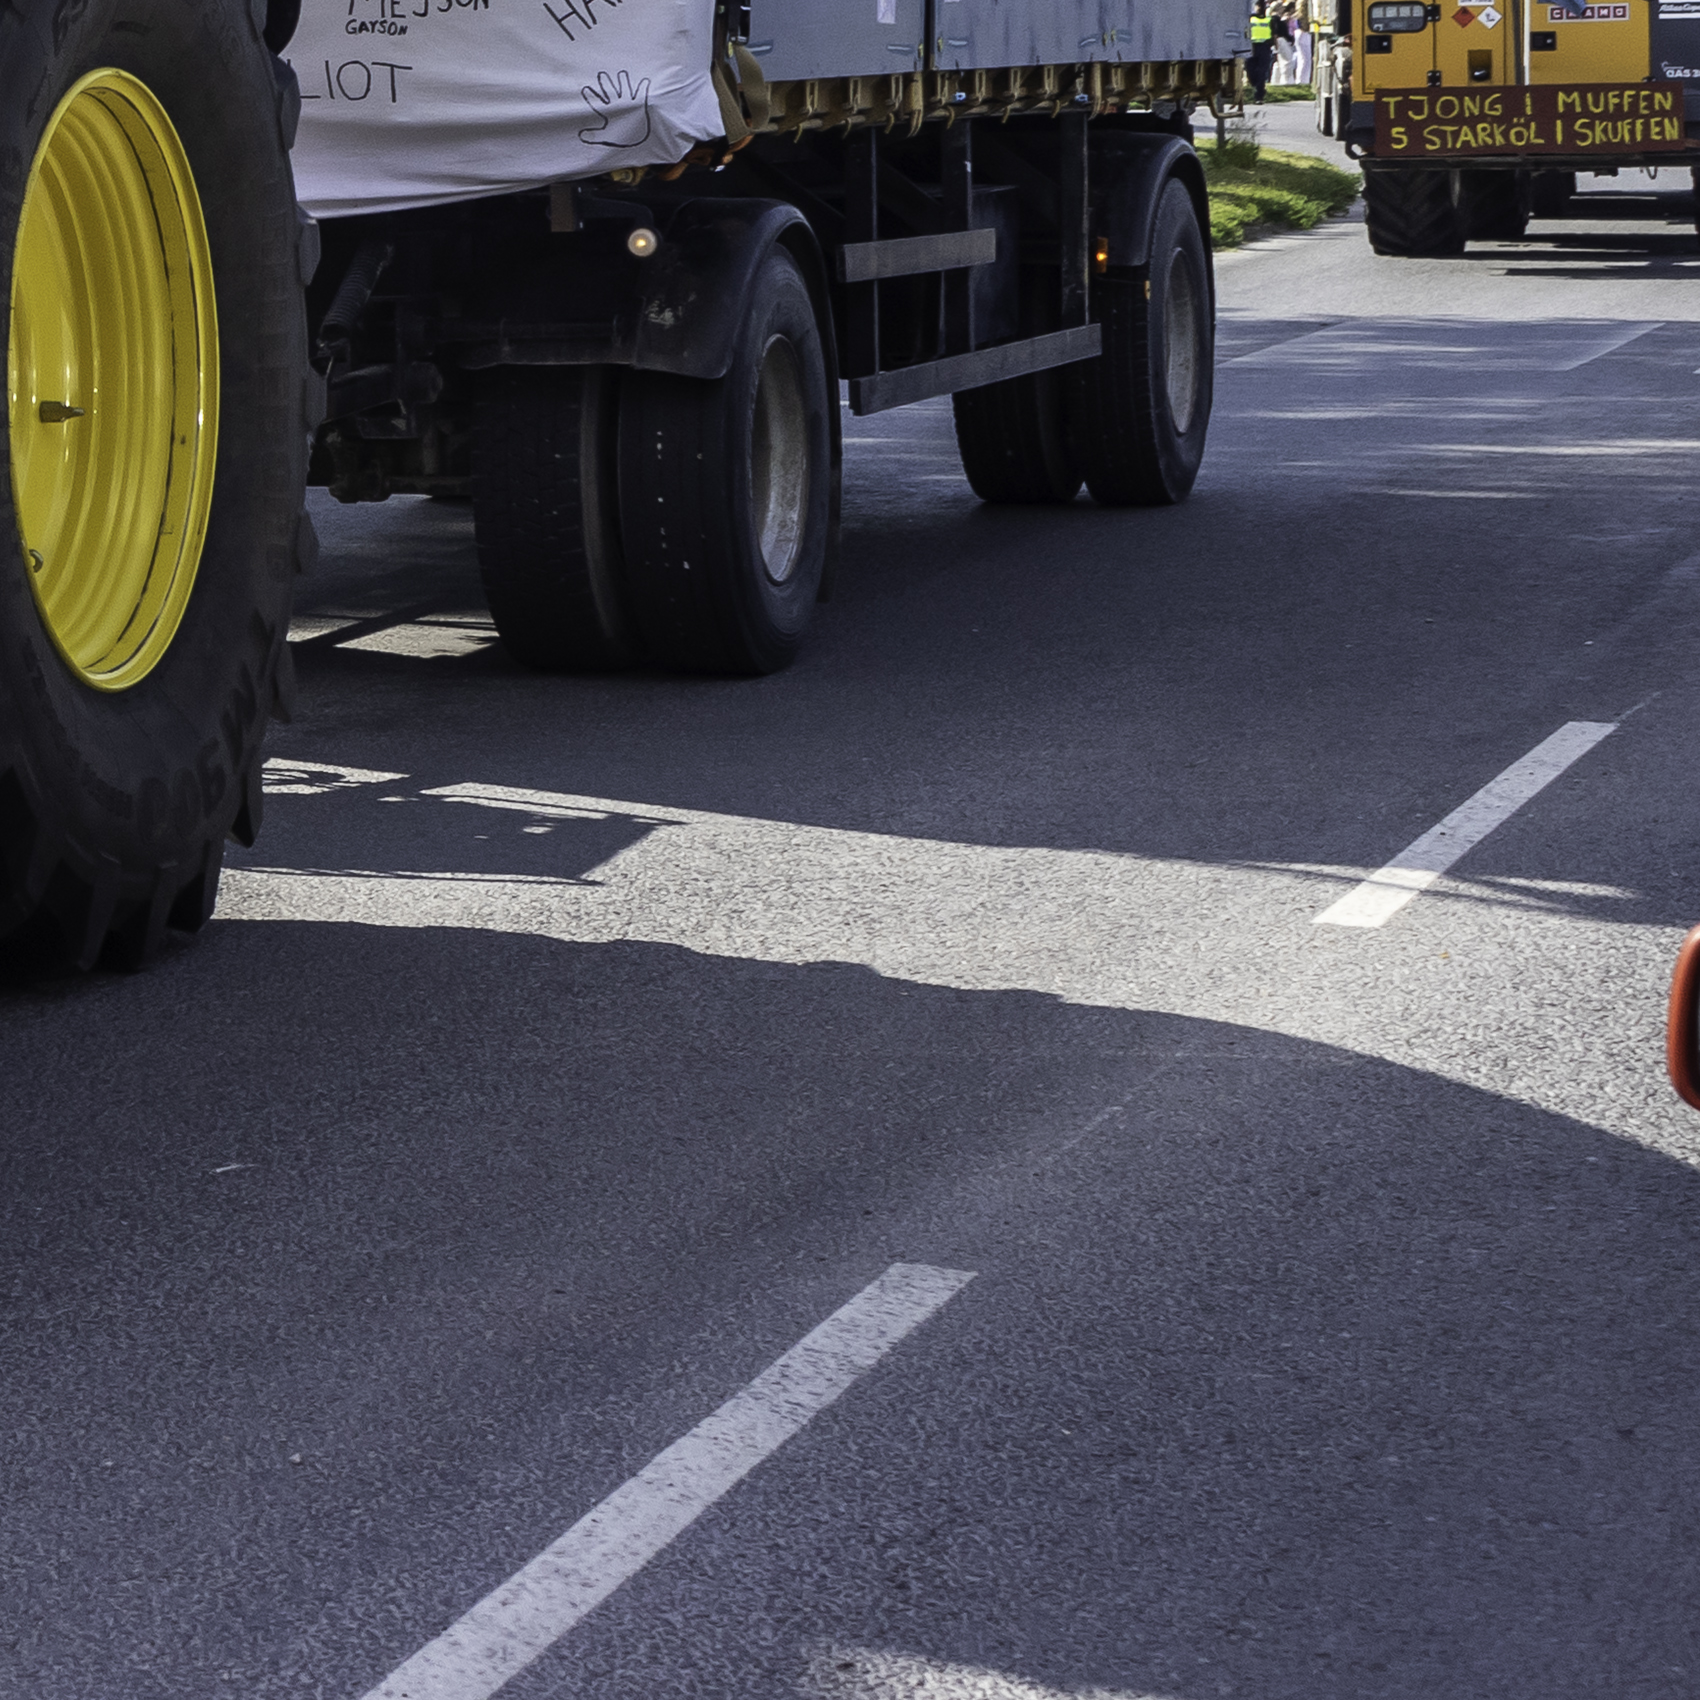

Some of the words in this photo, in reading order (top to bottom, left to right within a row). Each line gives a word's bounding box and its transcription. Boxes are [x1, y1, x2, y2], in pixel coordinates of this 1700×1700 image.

[344, 18, 409, 37] GAYSON
[1381, 92, 1503, 121] TJONG
[1557, 90, 1674, 115] MUFFEN
[1422, 117, 1546, 151] STARKÖL
[1573, 116, 1680, 147] SKUFFEN
